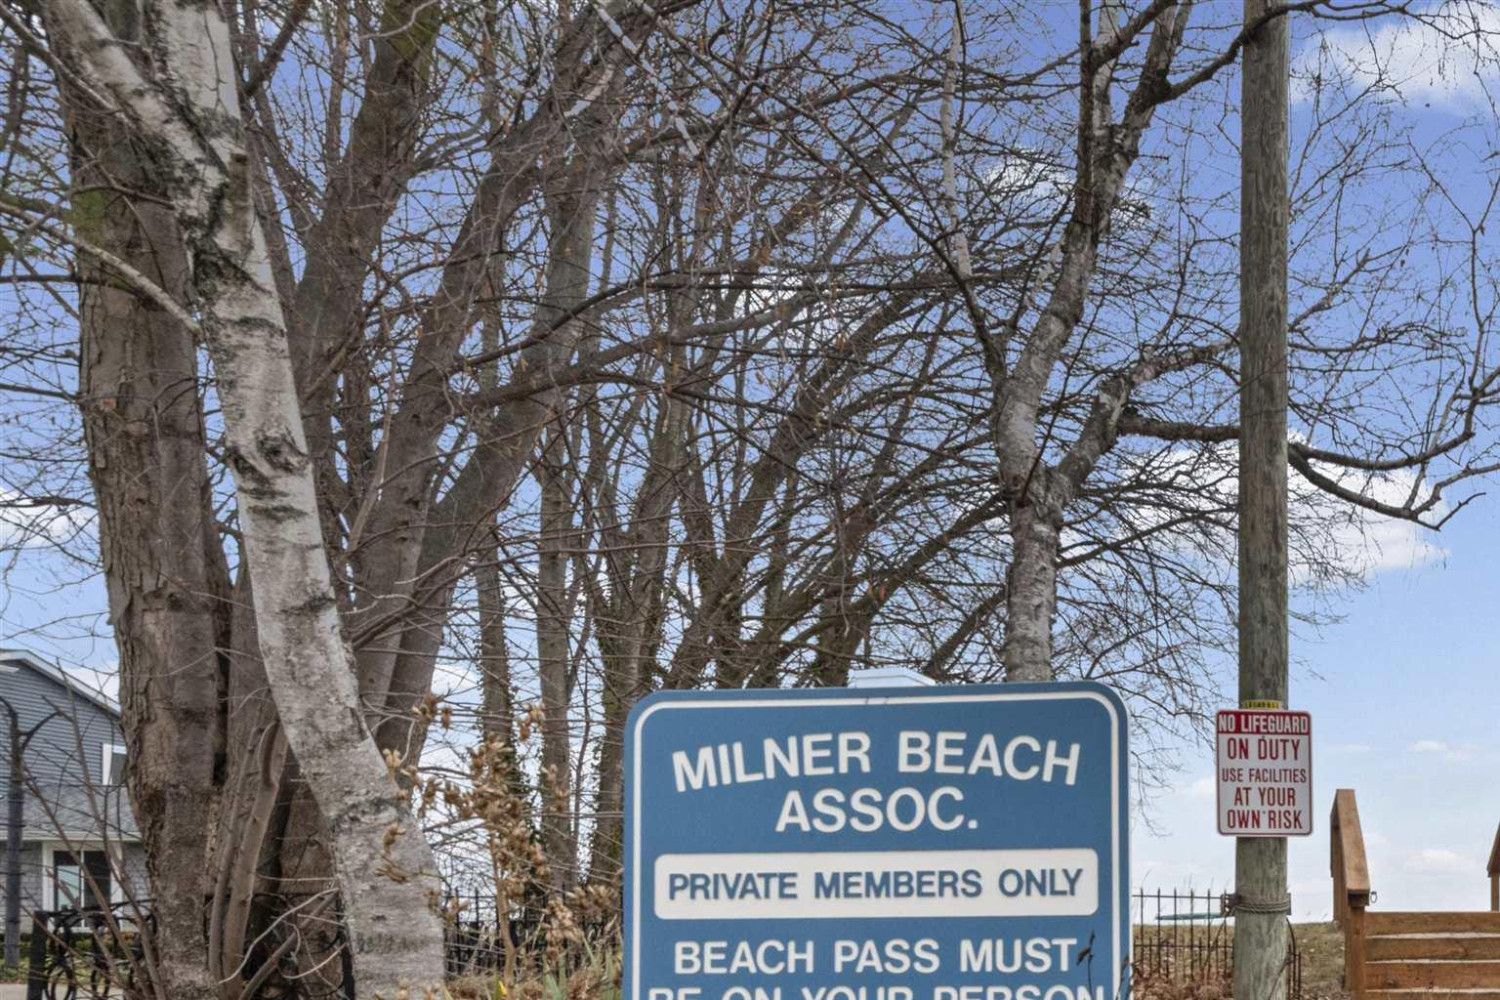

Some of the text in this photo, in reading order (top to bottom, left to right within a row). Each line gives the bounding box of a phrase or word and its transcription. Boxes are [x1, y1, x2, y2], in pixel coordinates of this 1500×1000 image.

[1218, 714, 1308, 733] NO LIFEGUARD
[672, 730, 1081, 792] MILNER BEACH
[1227, 737, 1301, 761] ON DUTY
[1222, 768, 1307, 783] USE FACILITIES
[1234, 787, 1296, 807] AT YOUR
[775, 786, 979, 833] ASSOC.
[1227, 809, 1303, 829] OWN RISK
[668, 867, 1083, 901] PRIVATE MEMBERS ONLY
[674, 938, 1077, 974] BEACH PASS MUST
